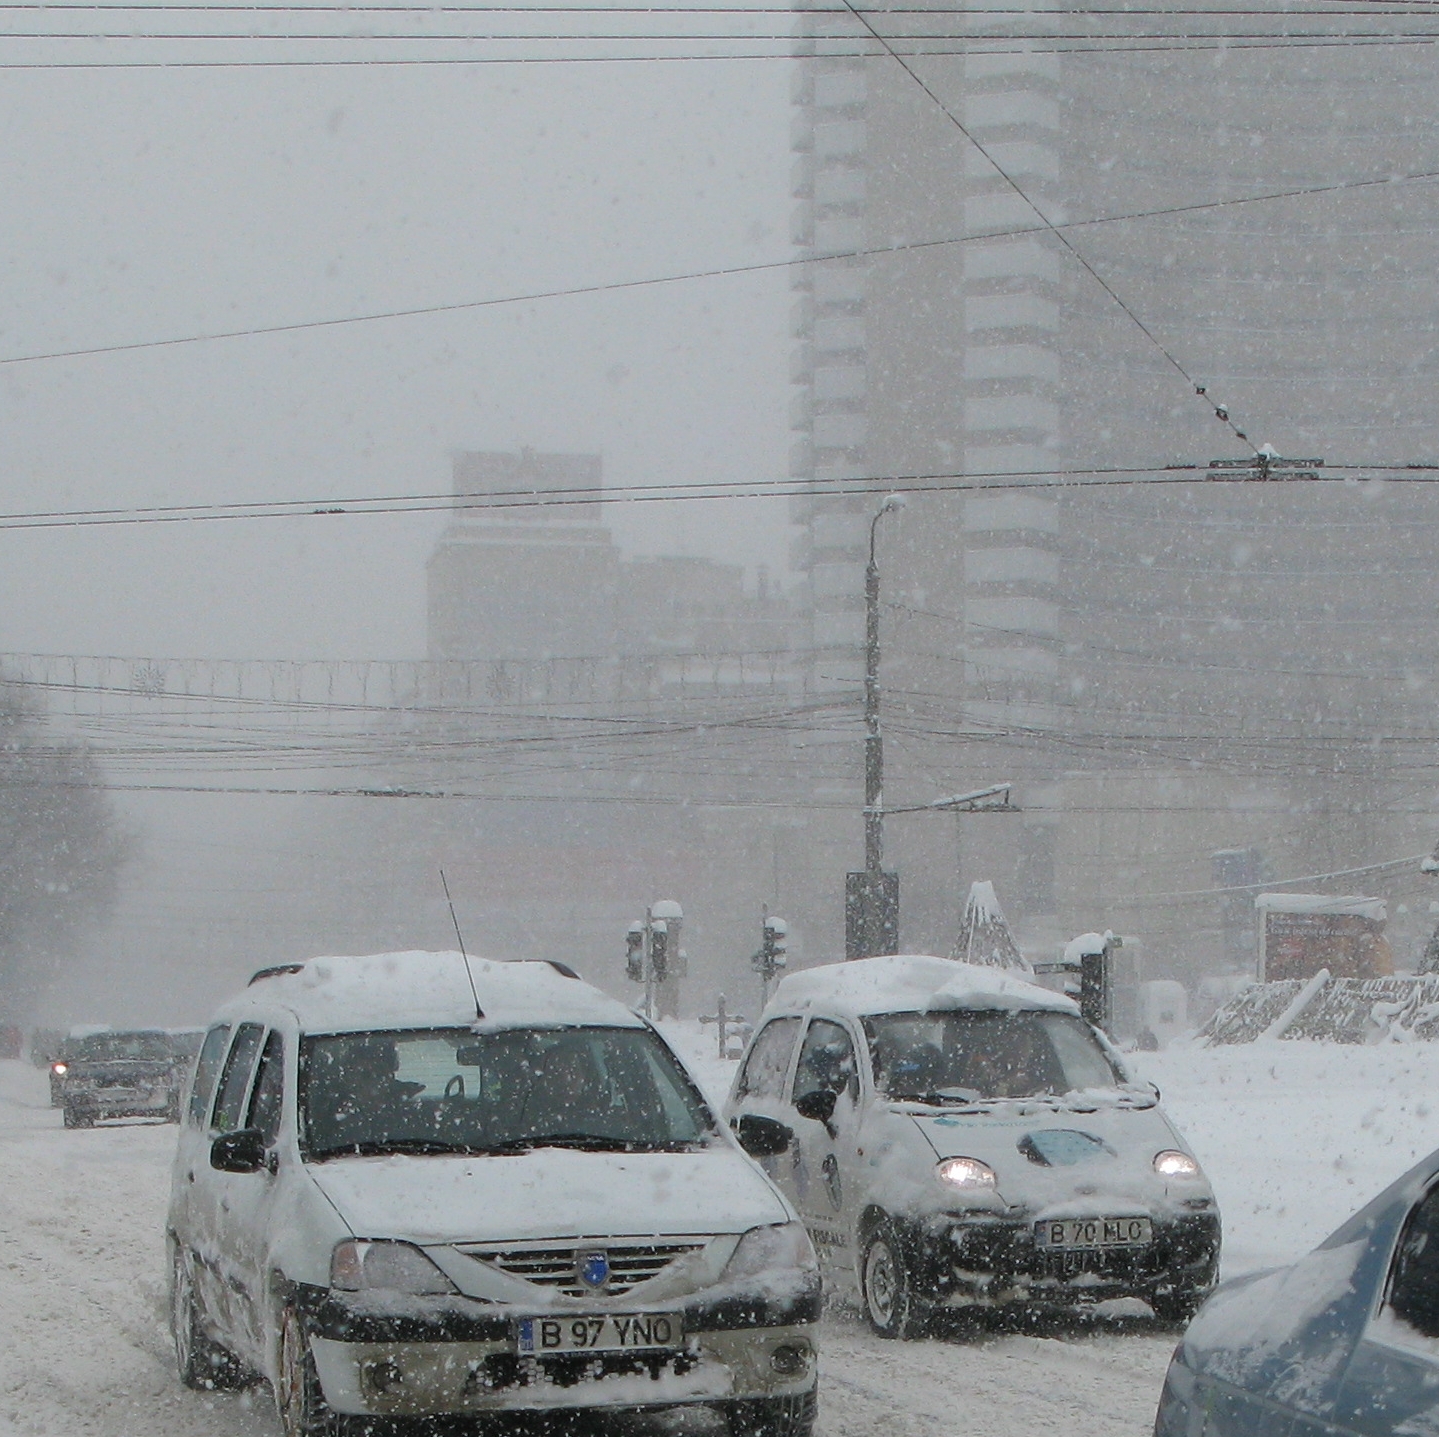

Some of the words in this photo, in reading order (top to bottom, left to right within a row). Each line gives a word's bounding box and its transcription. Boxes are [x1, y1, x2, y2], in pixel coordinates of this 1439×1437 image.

[1050, 1223, 1065, 1243] B
[1072, 1222, 1096, 1243] 70
[541, 1321, 562, 1348] B
[571, 1320, 605, 1347] 97
[613, 1317, 673, 1346] YNO
